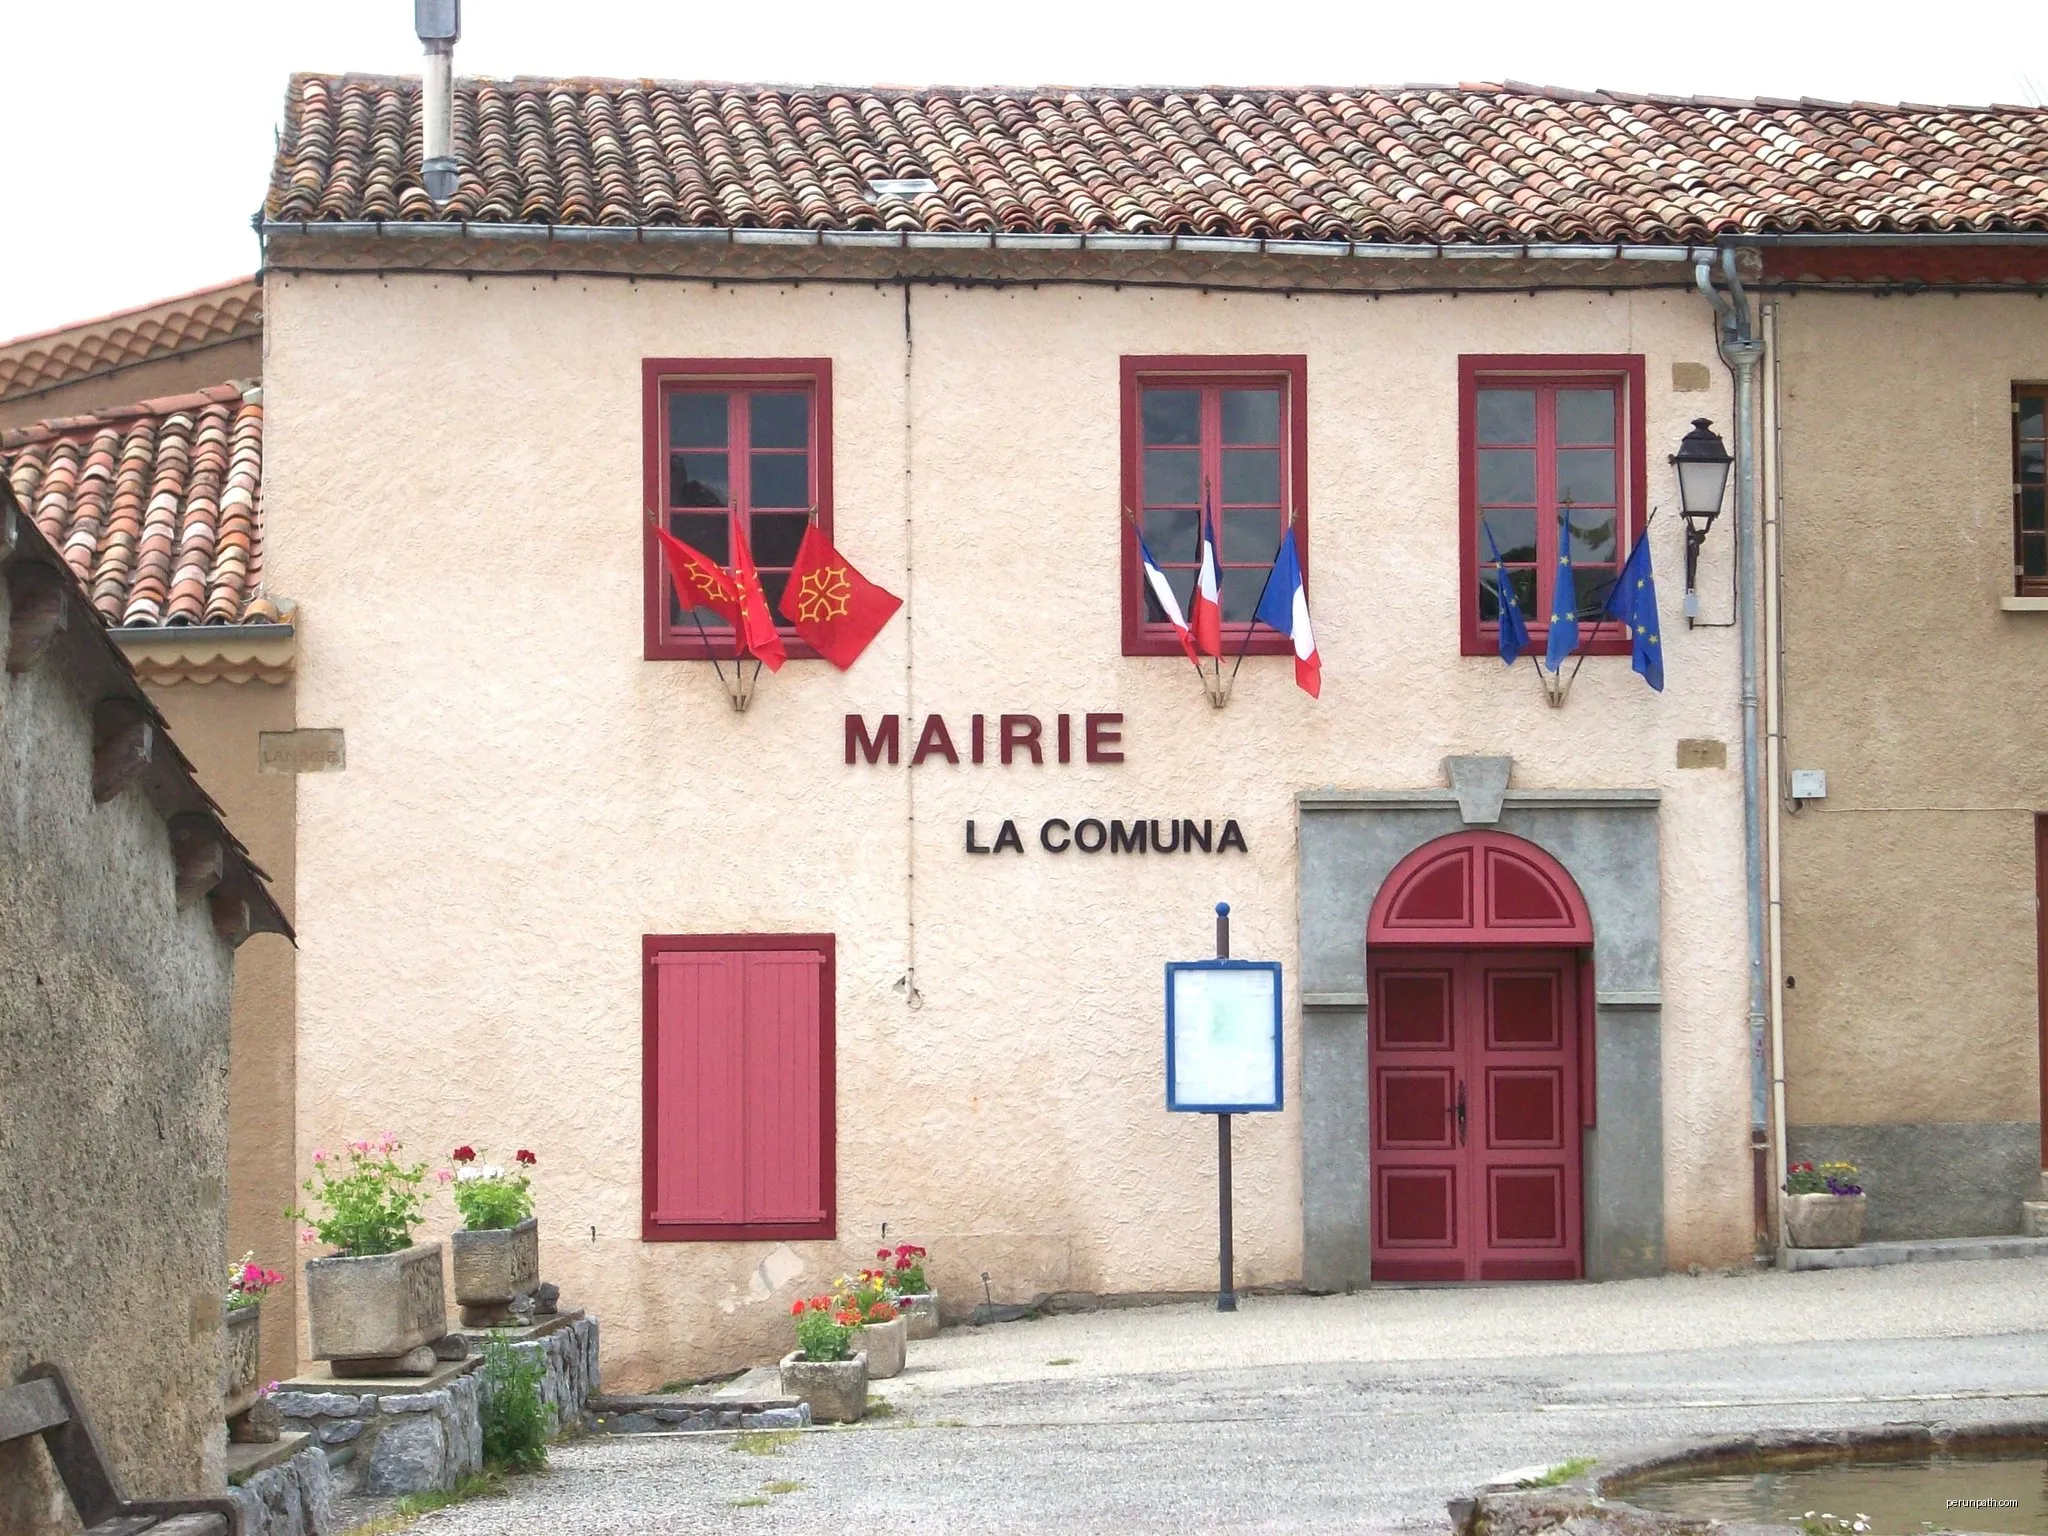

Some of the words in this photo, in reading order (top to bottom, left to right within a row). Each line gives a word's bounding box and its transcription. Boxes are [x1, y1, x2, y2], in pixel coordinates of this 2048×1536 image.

[845, 713, 1125, 765] MAIRIE
[966, 819, 1025, 854] LA
[1040, 818, 1249, 854] COMUNA
